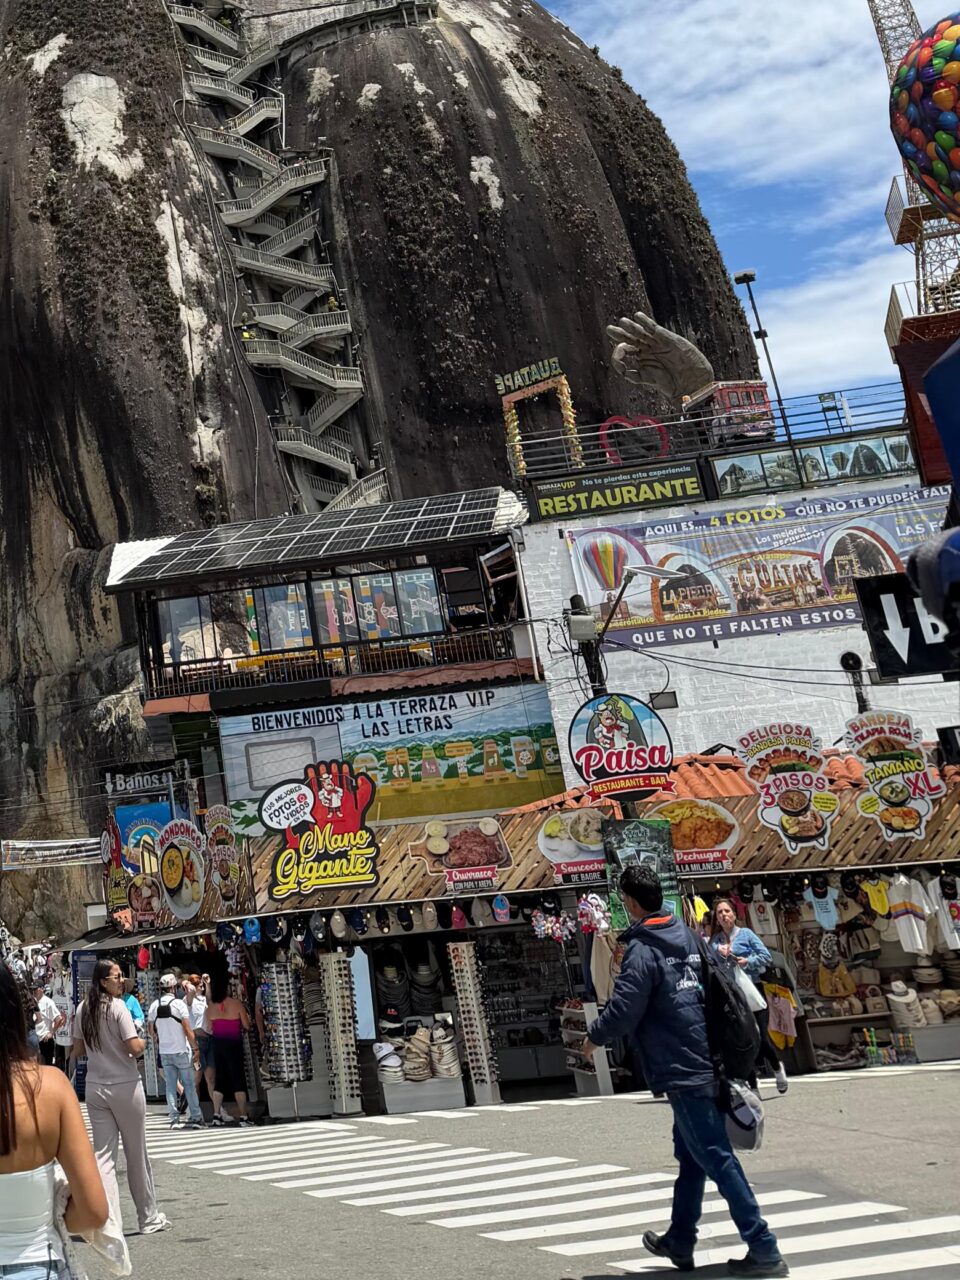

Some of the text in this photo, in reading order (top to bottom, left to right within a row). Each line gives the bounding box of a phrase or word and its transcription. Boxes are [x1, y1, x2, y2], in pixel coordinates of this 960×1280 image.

[560, 480, 576, 490] VIP
[582, 479, 593, 487] No
[603, 474, 631, 484] pierdas
[632, 471, 647, 480] esta
[649, 466, 691, 478] experiencia
[538, 477, 700, 516] RESTAURANTE
[645, 524, 677, 537] AQUI
[710, 516, 721, 527] 4
[726, 507, 786, 525] FOTOS
[795, 504, 823, 517] QUE
[826, 501, 847, 513] NO
[850, 498, 865, 509] TE
[872, 491, 919, 506] PUEDEN
[923, 486, 952, 499] FALT
[755, 526, 806, 545] Los mejores
[895, 523, 925, 537] LAS
[662, 589, 677, 605] LA
[632, 608, 856, 644] QUE NO TE FALTEN ESTOS
[252, 690, 496, 732] BIENVENIDOS A LA TERRAZA VIP
[848, 713, 910, 733] BANDEJA
[361, 714, 454, 739] LAS LETRAS
[739, 723, 812, 749] DELICIOSA
[888, 726, 913, 741] ROJA
[747, 736, 812, 758] BANDEJA PAISA
[575, 741, 672, 781] Paisa
[865, 757, 925, 784] TAMAÑO
[116, 773, 159, 791] Baños
[593, 777, 645, 793] RESTAURANTE
[650, 776, 667, 785] BAR
[760, 773, 826, 807] 3 PISOS
[906, 771, 942, 797] XL
[264, 785, 303, 813] TUS MEJORES
[268, 797, 297, 822] FOTOS
[276, 801, 309, 826] Y VIDEOS
[160, 823, 201, 849] MONDONGO
[300, 823, 370, 854] Mano
[675, 851, 722, 862] Pechuga
[681, 864, 689, 872] LA
[690, 862, 723, 871] MILANESA
[273, 847, 376, 898] Gigante
[571, 872, 602, 882] DE BAGRE
